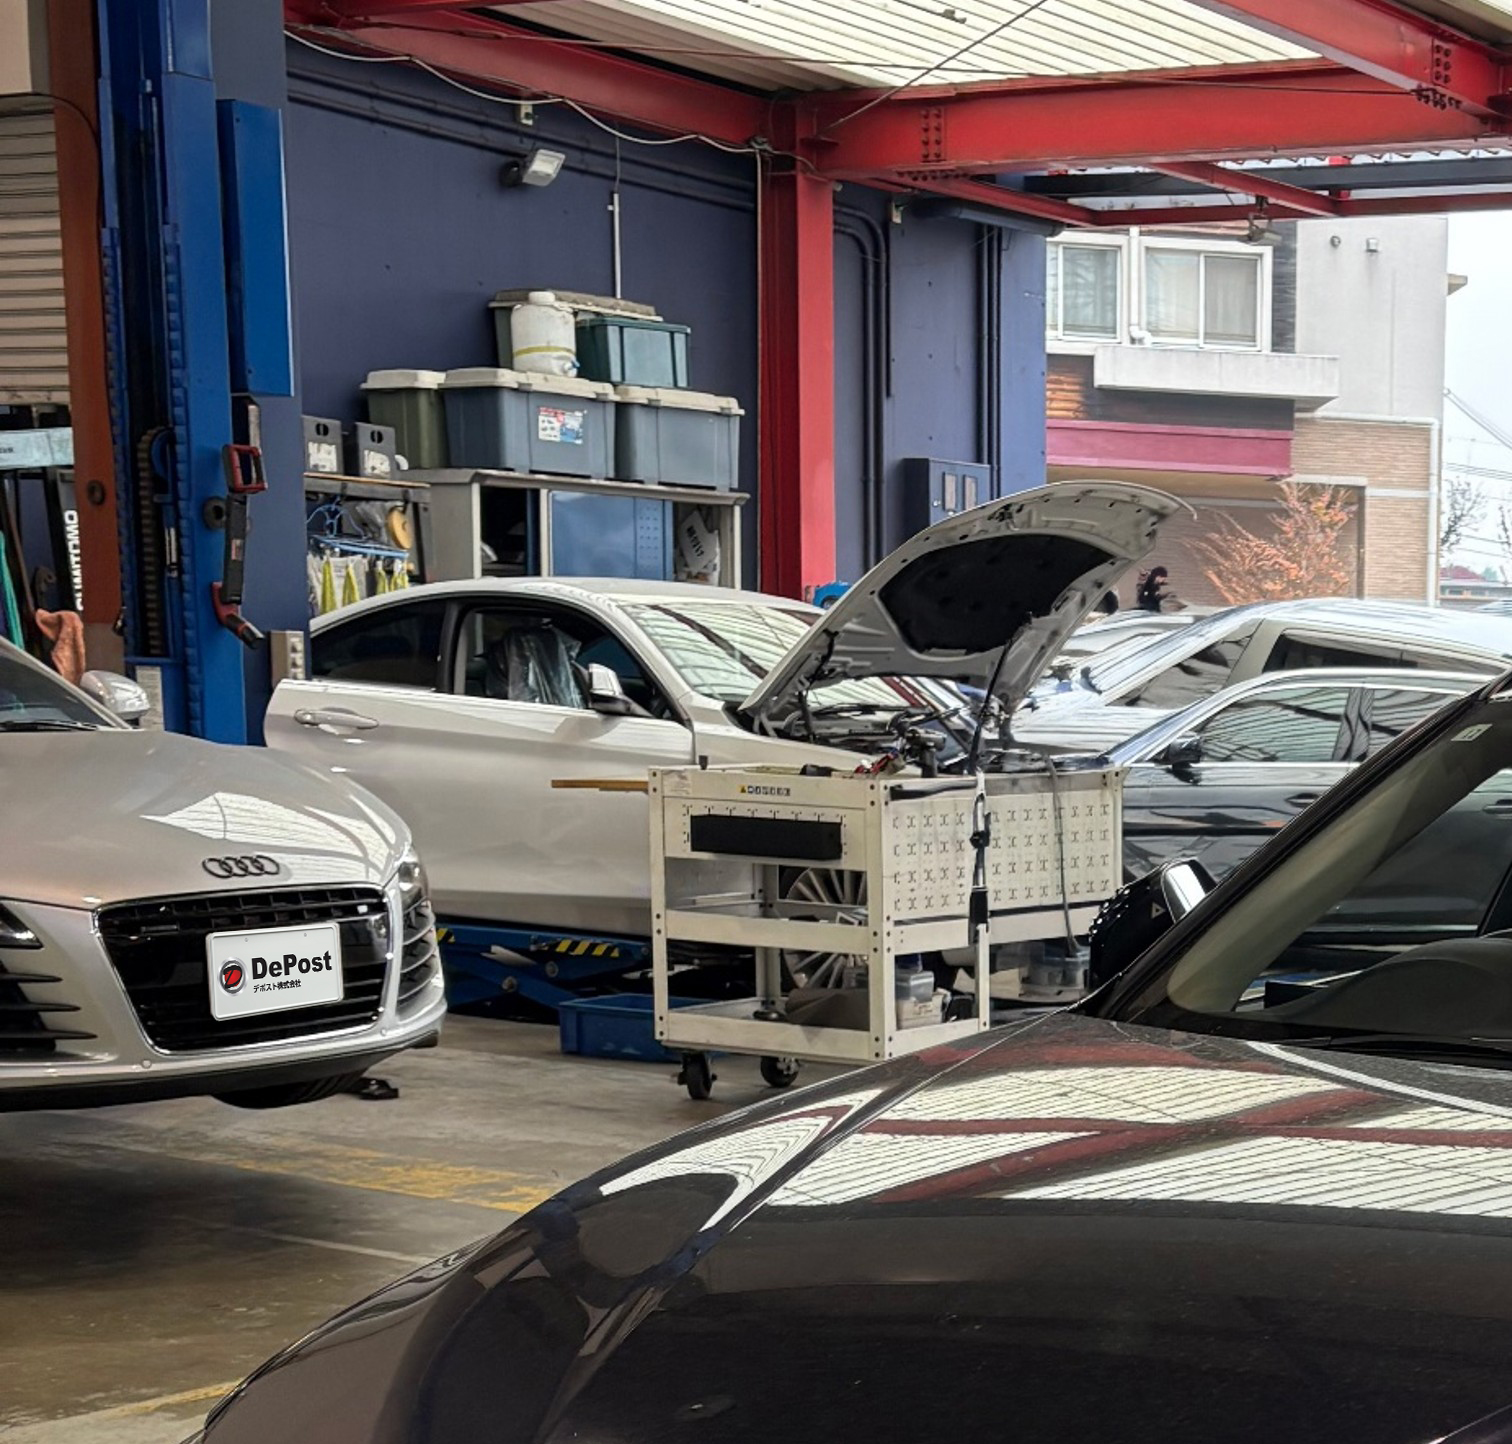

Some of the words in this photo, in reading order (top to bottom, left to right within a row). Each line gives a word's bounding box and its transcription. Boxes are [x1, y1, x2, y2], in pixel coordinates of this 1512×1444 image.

[252, 951, 332, 980] DePost
[253, 979, 302, 993] デポスト株式会社
